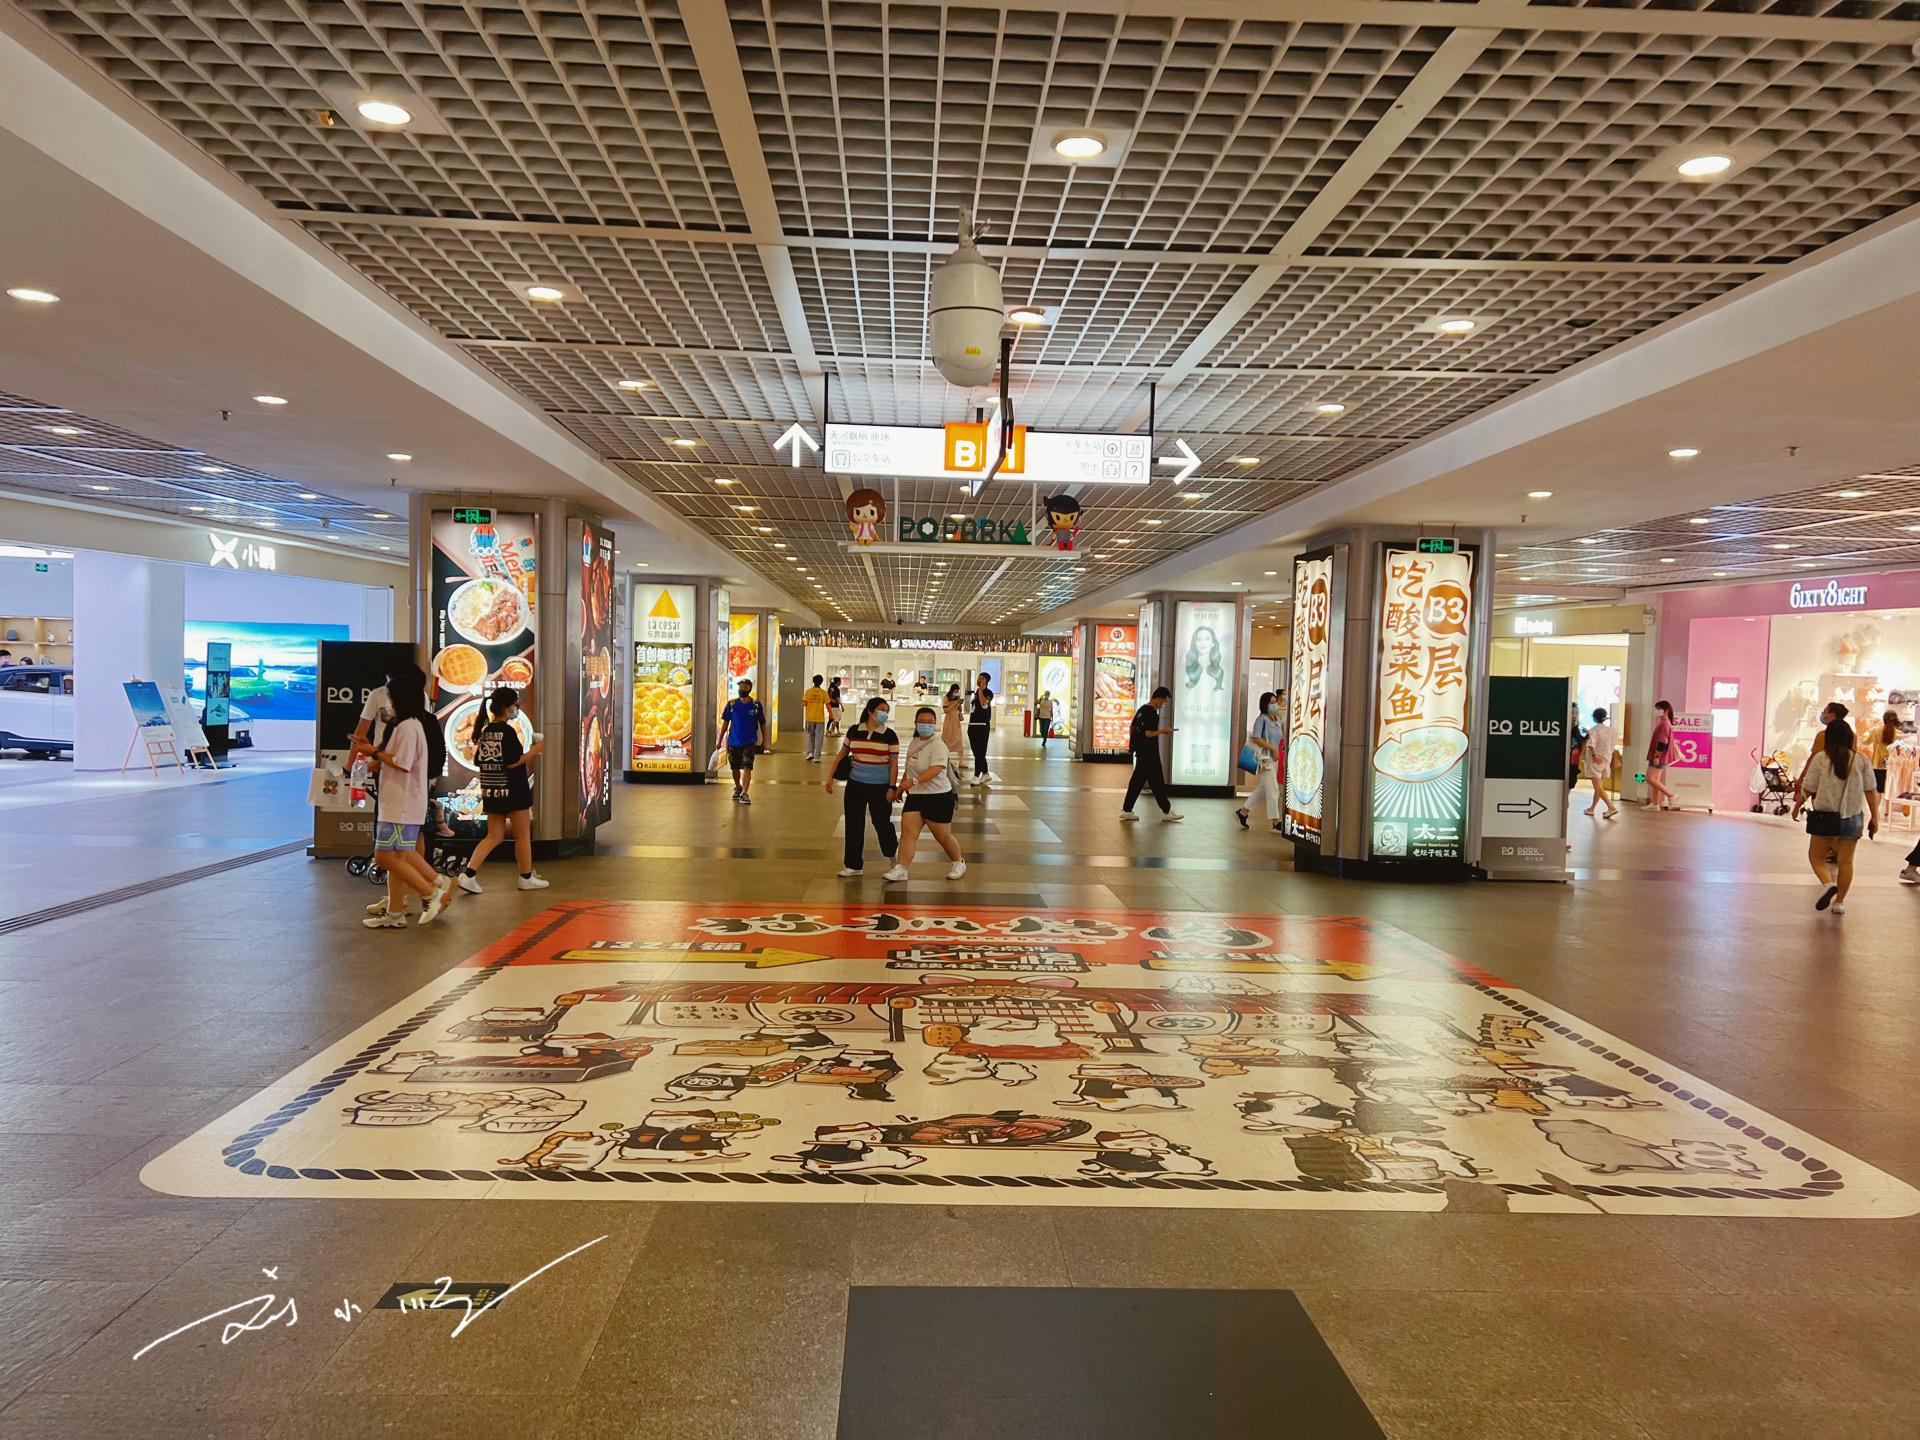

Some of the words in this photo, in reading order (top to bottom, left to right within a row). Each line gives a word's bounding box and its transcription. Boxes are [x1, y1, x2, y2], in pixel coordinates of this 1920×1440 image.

[1309, 592, 1327, 628] B3
[1428, 596, 1466, 625] B3
[648, 620, 657, 630] La
[901, 638, 953, 650] SWAROVSKI
[1384, 559, 1427, 726] 吃酸菜鱼
[1420, 643, 1463, 691] 层
[1519, 720, 1560, 736] PLUS
[1671, 718, 1701, 727] SALE
[1412, 823, 1459, 841] 太二
[947, 944, 1050, 952] 大众点评
